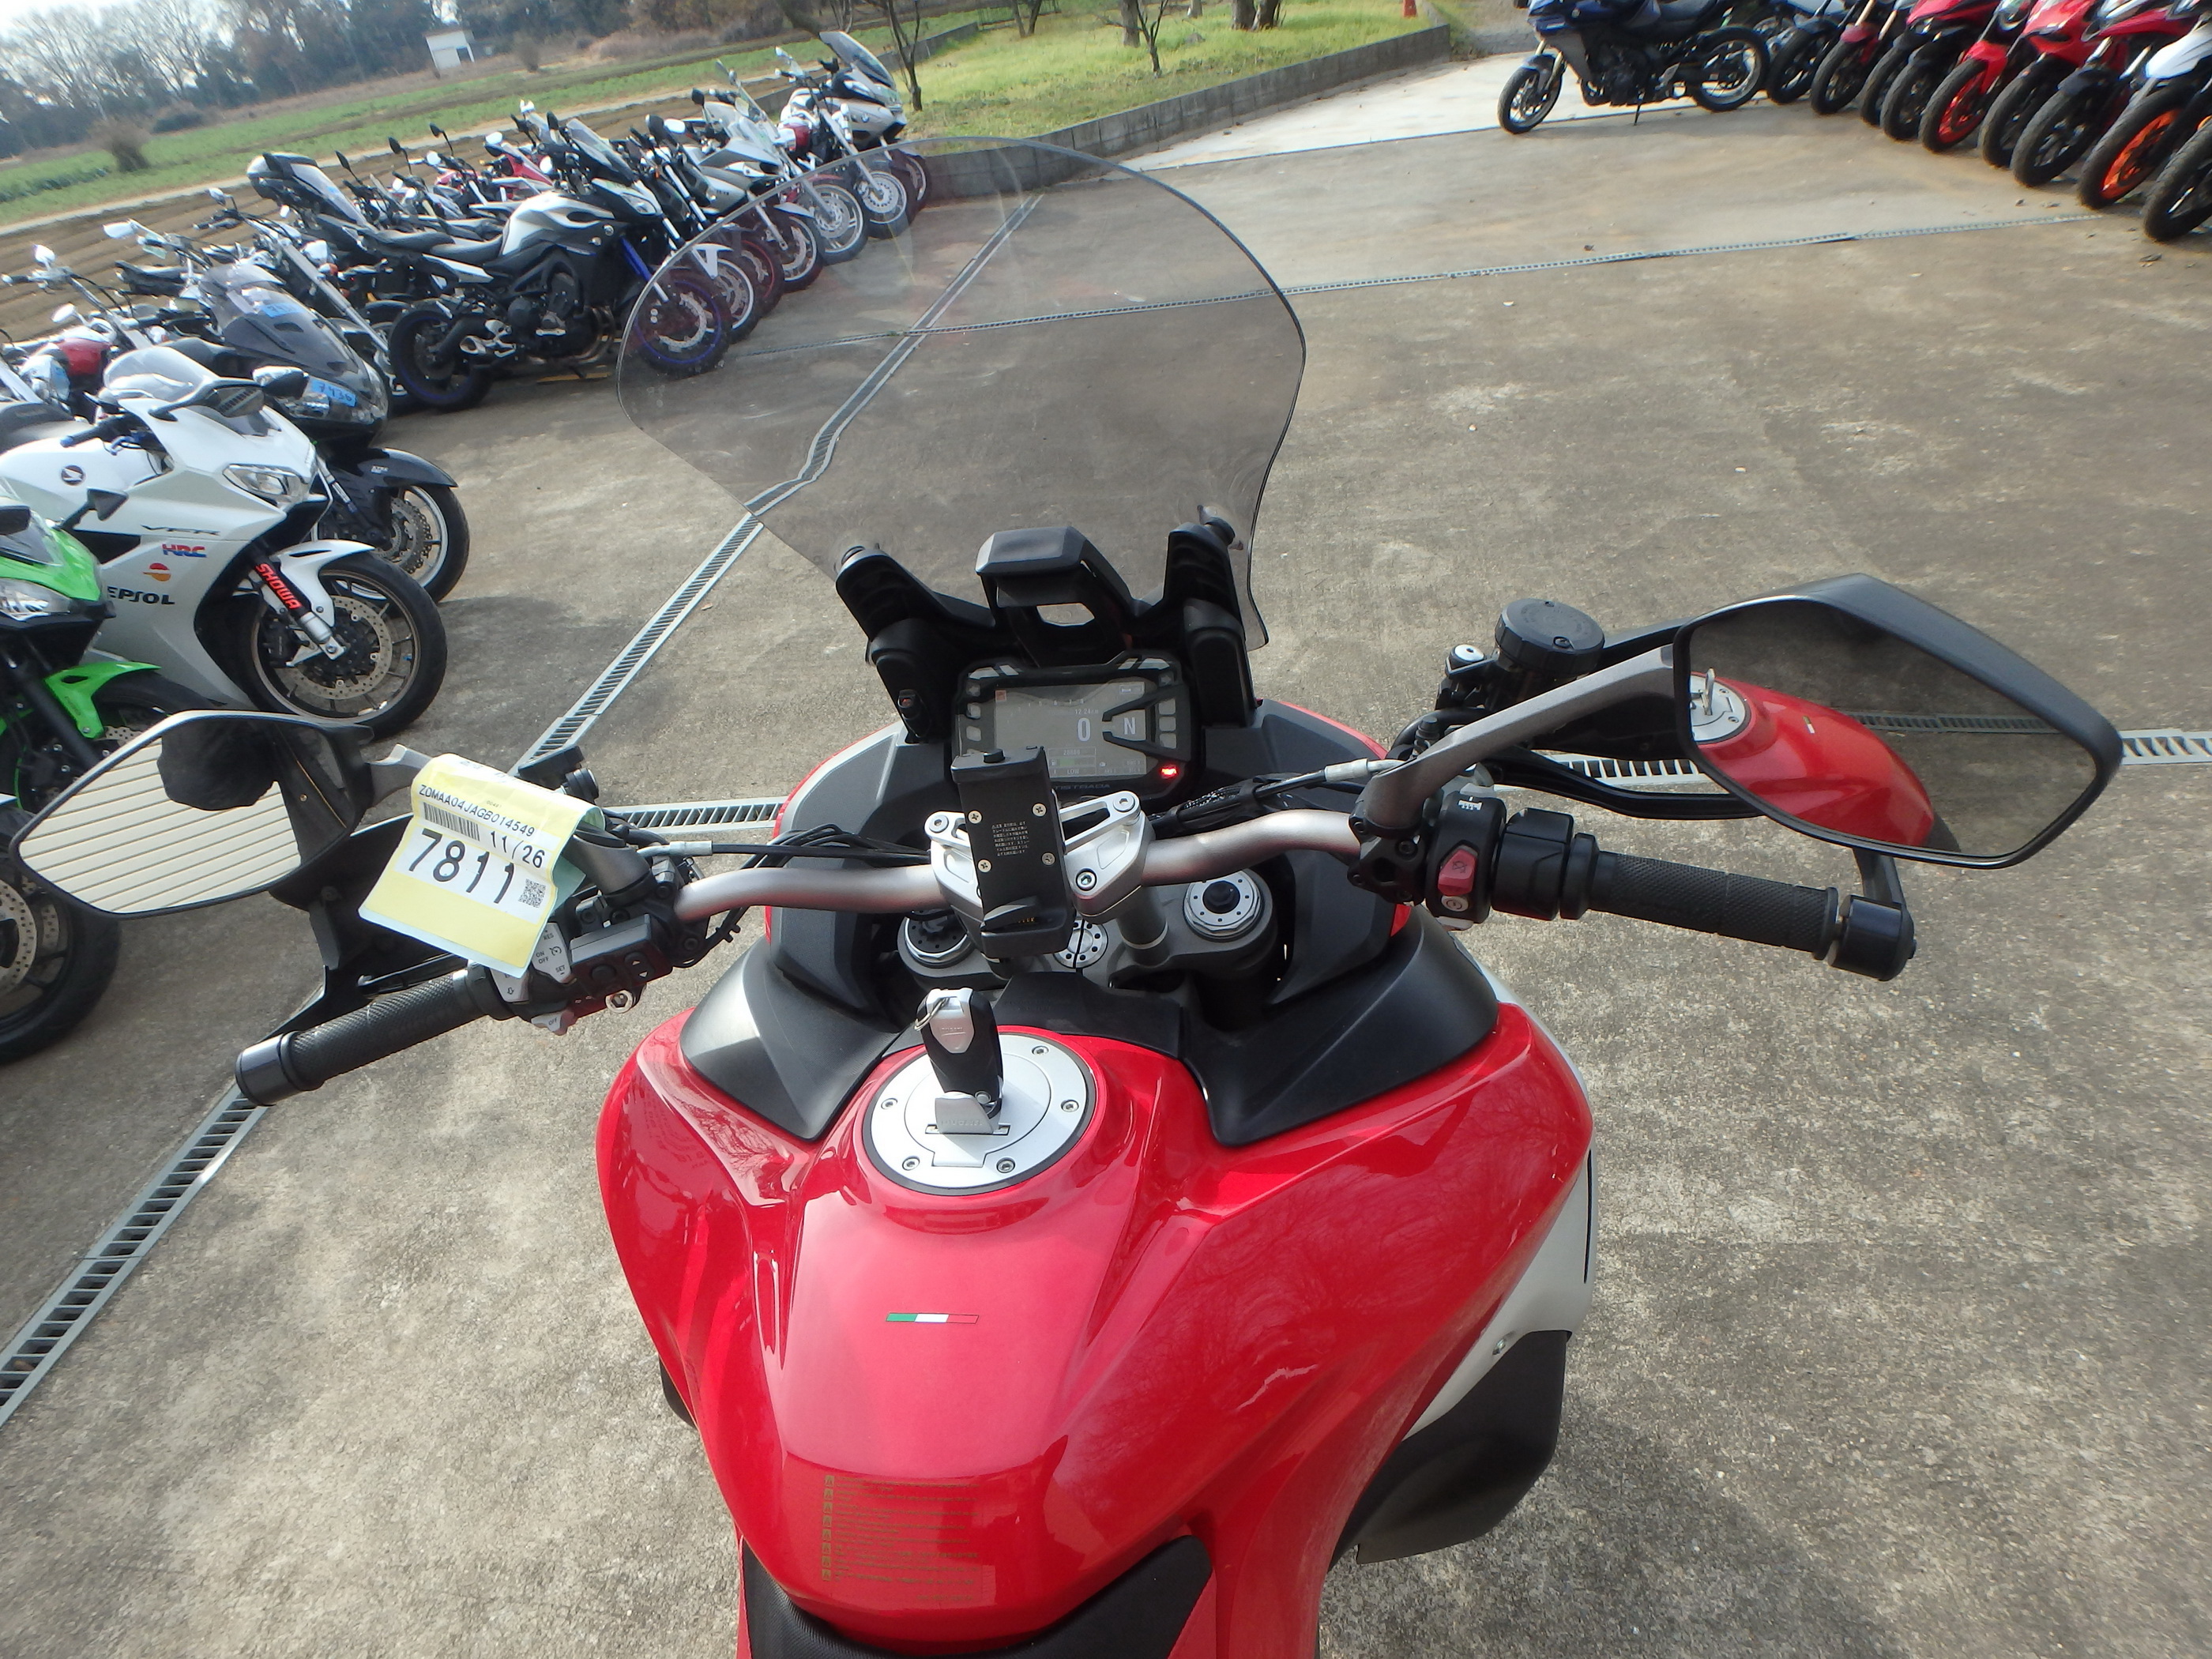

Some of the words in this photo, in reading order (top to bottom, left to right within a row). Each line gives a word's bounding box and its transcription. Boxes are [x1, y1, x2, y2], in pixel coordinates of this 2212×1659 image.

[162, 544, 207, 559] HRC
[107, 585, 175, 605] EPSOL
[255, 563, 302, 609] SHOWA
[1077, 717, 1091, 742] 0
[1123, 717, 1136, 735] N
[491, 830, 545, 869] 11/26
[408, 828, 514, 904] 7811
